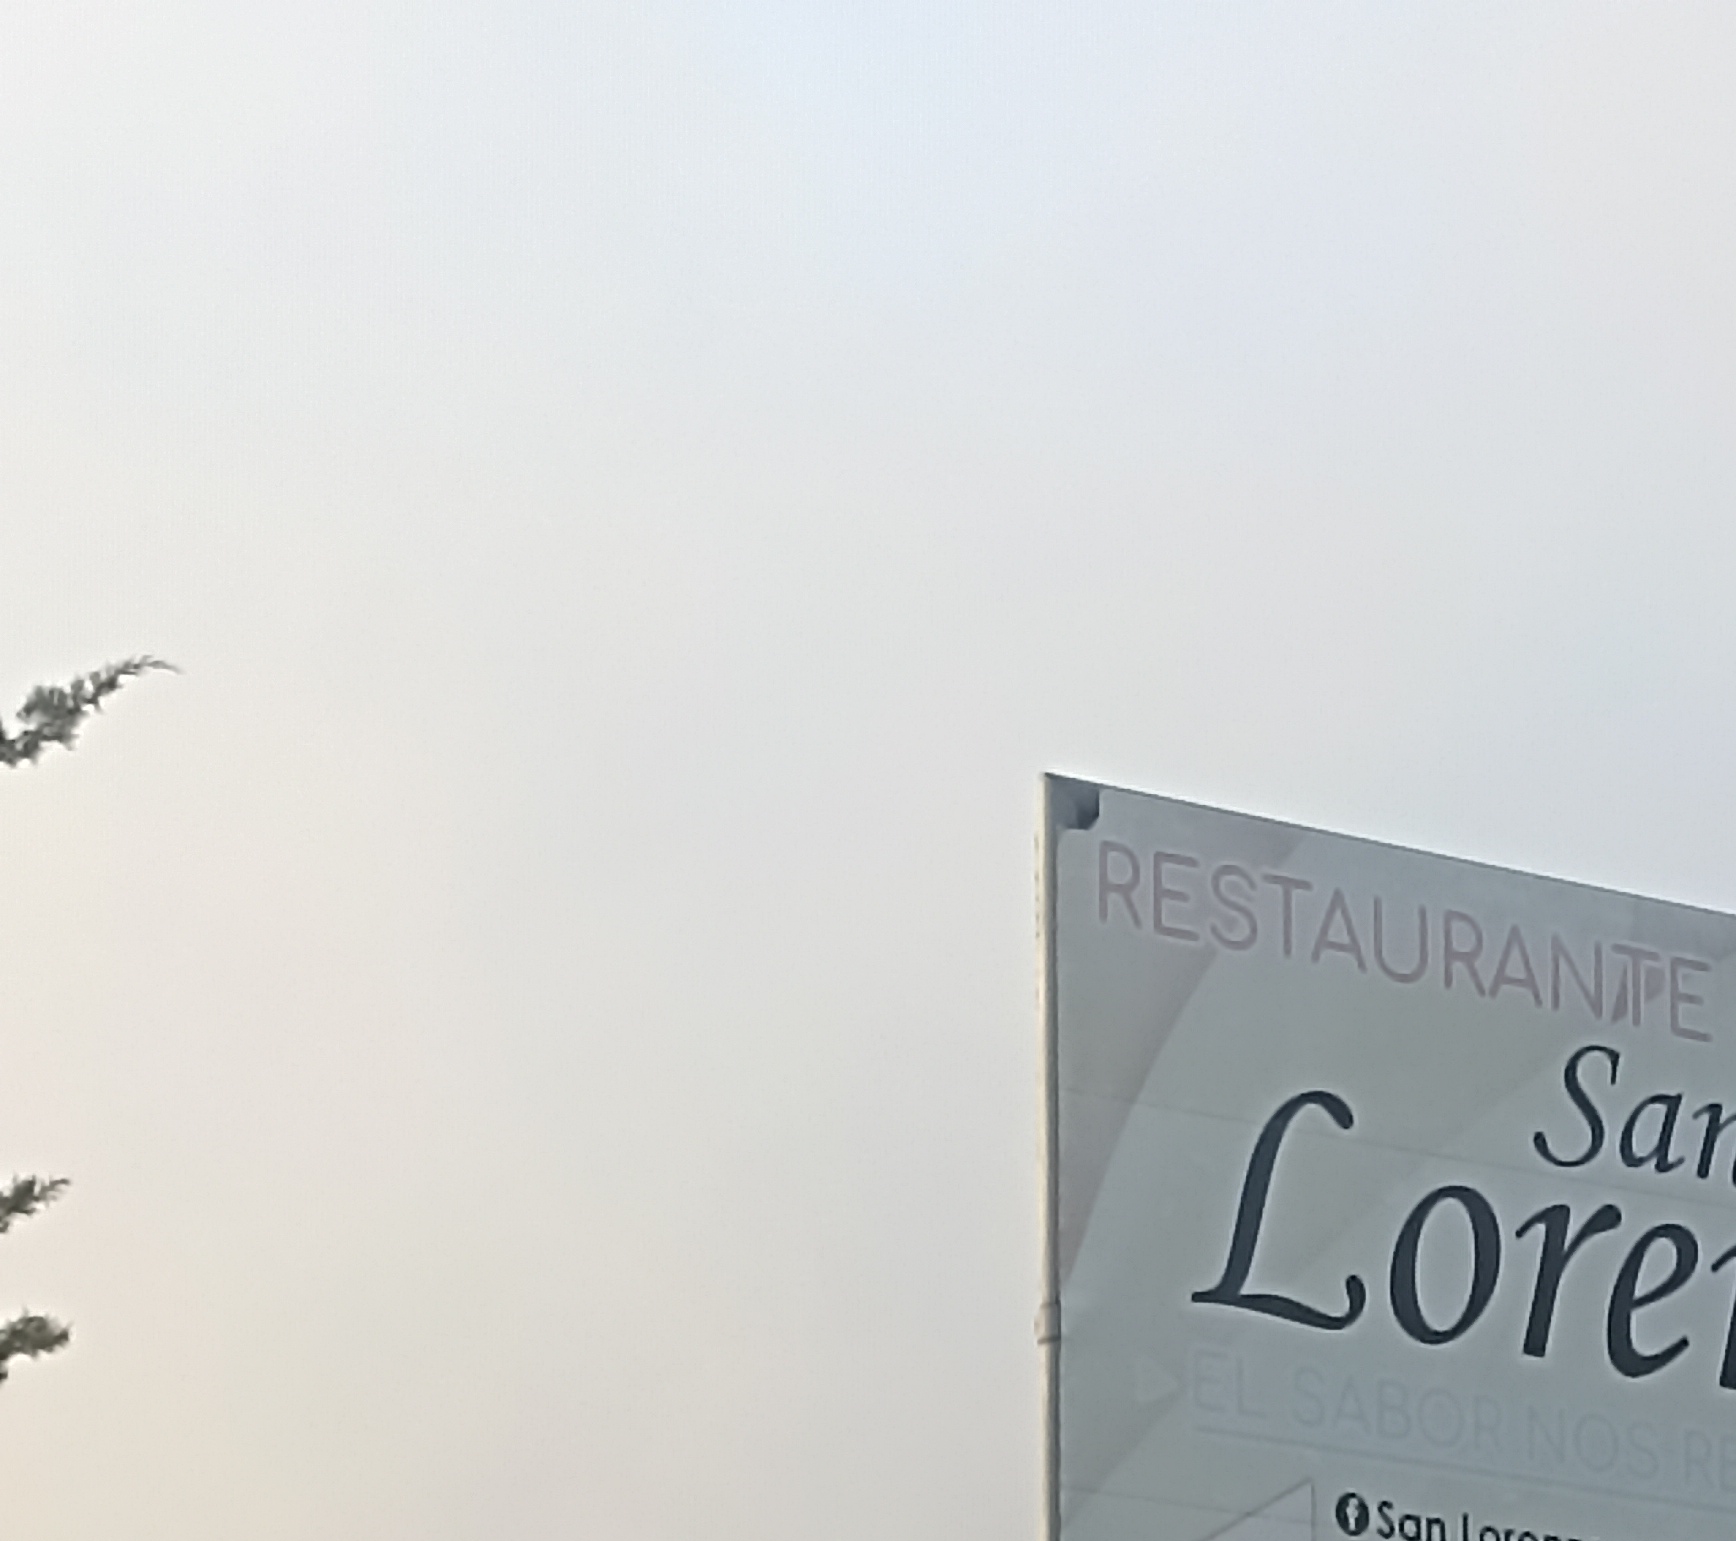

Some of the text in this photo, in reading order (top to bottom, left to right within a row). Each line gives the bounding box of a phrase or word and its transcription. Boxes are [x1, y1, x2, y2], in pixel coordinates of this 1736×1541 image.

[1098, 839, 1714, 1043] RESTAURANTE
[1194, 1349, 1268, 1420] EL
[1294, 1366, 1499, 1451] SABOR
[1527, 1404, 1660, 1479] NOS
